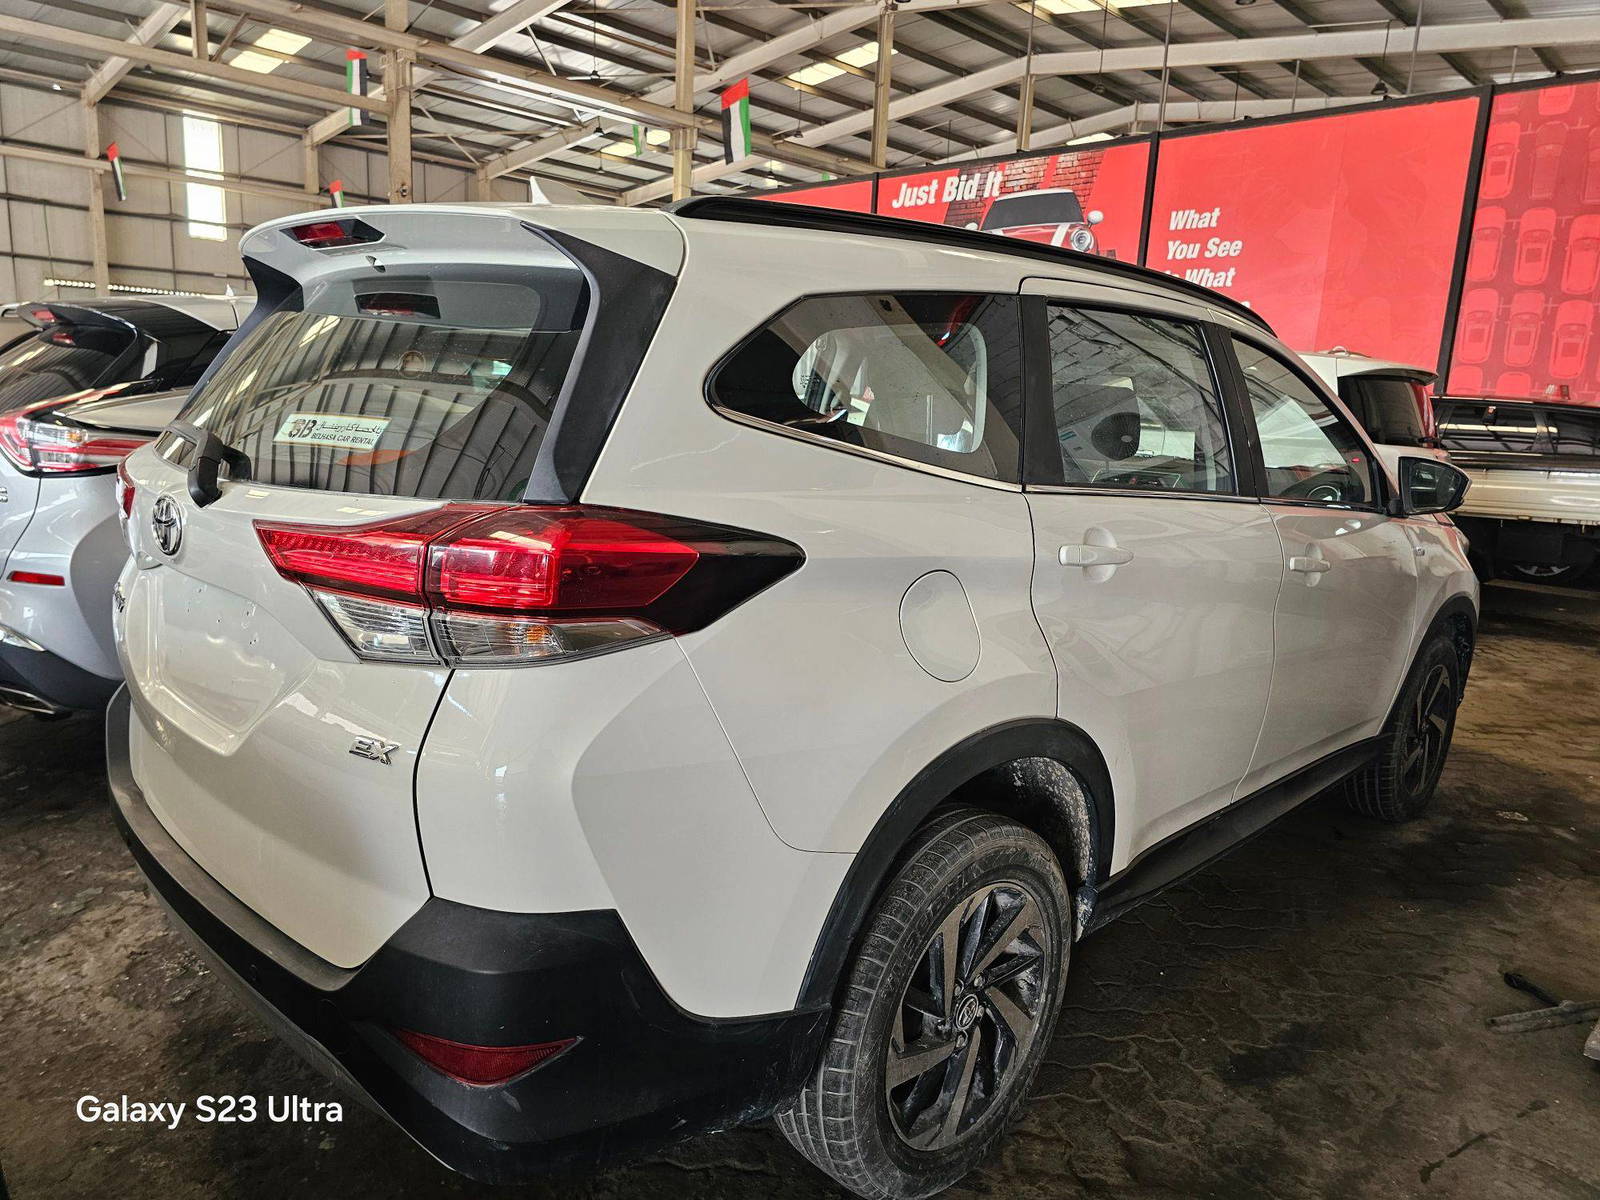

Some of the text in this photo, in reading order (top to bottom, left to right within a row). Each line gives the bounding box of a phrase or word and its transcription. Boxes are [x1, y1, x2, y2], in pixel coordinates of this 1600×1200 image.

[892, 170, 1003, 208] Just Bid It
[1169, 208, 1220, 231] What
[1167, 237, 1243, 260] You See
[1184, 267, 1236, 288] What
[311, 432, 374, 446] BELHASA CAR RENTAL
[349, 735, 400, 766] EX
